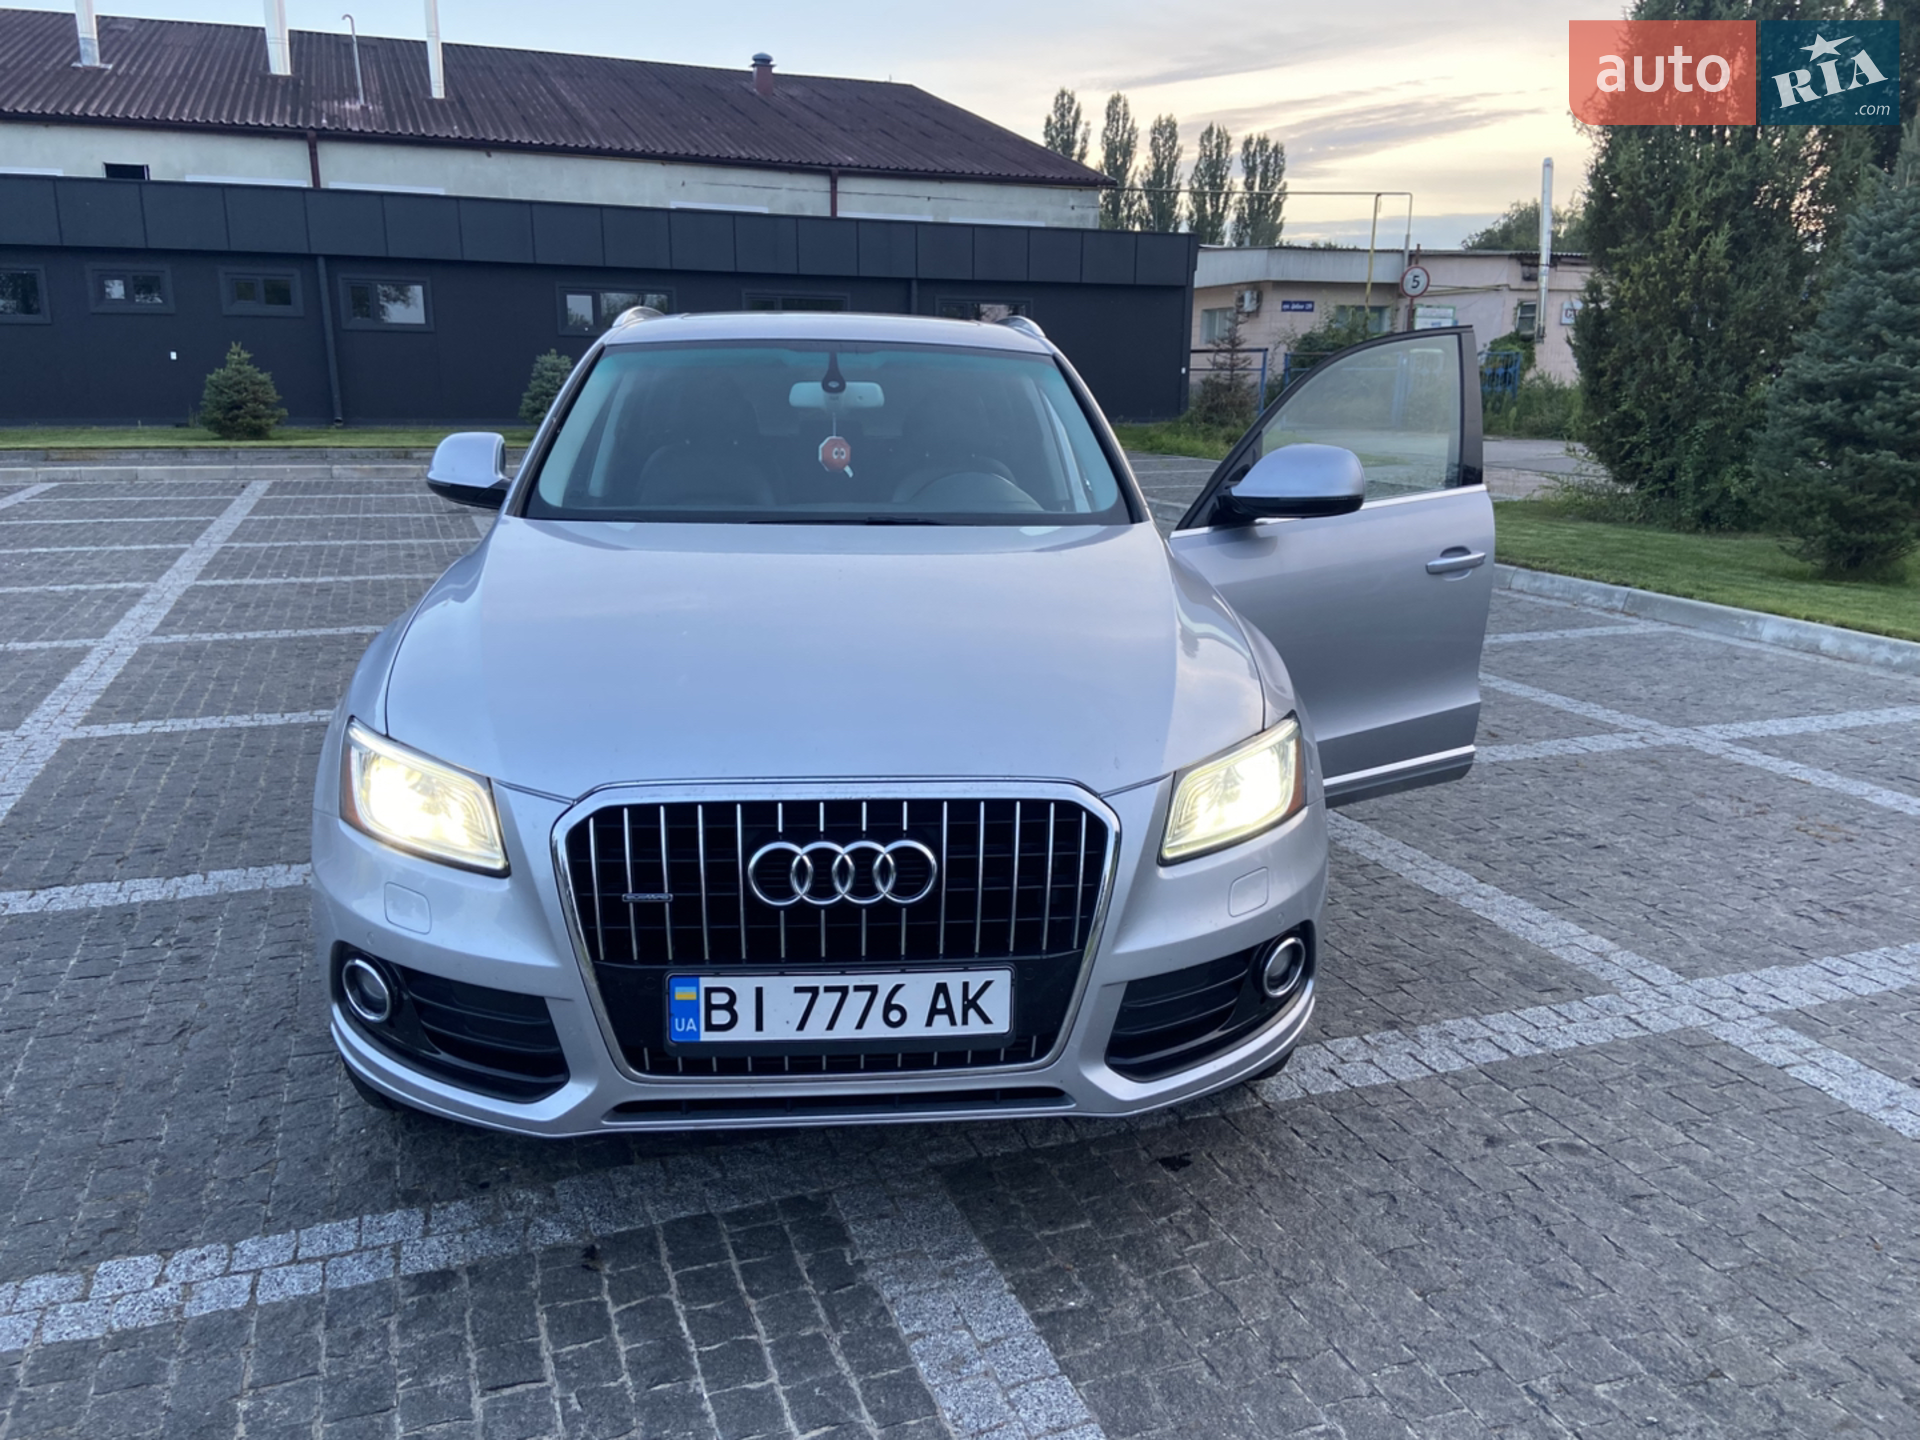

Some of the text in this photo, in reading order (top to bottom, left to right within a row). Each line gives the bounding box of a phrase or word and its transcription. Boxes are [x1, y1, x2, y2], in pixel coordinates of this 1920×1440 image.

[1411, 275, 1420, 289] 5
[703, 980, 995, 1032] BI 7776 AK
[674, 1018, 697, 1032] UA
